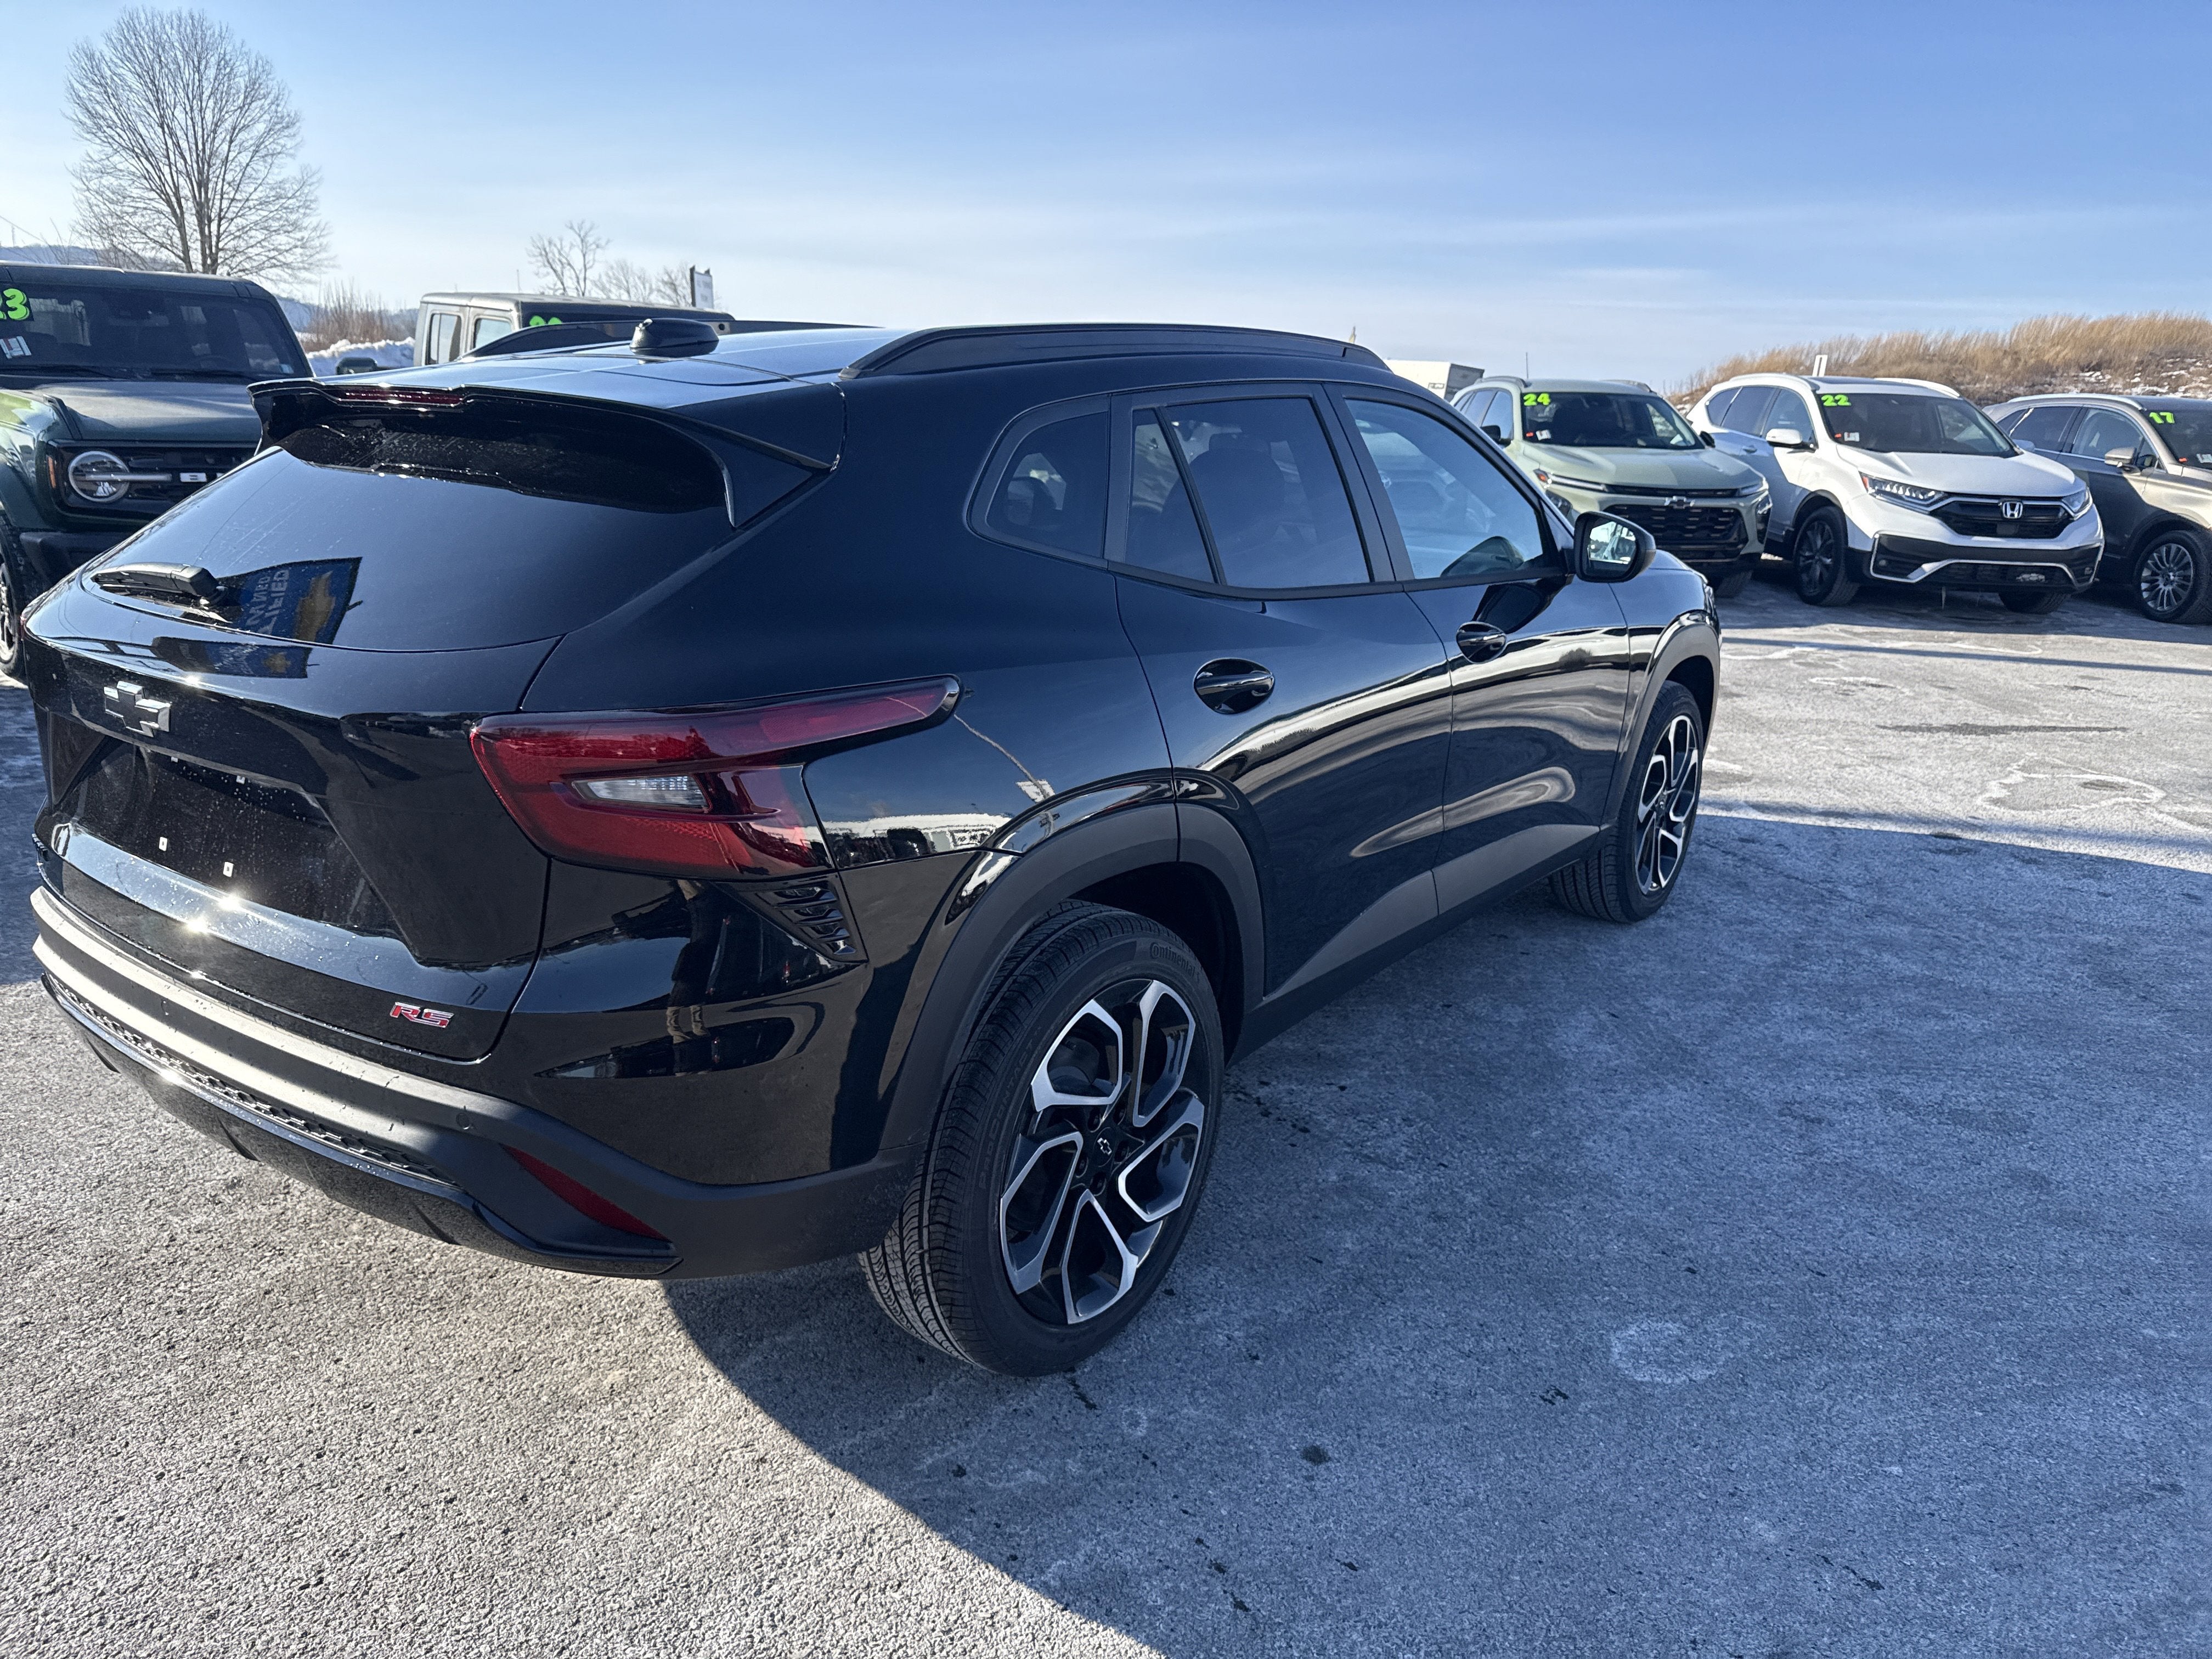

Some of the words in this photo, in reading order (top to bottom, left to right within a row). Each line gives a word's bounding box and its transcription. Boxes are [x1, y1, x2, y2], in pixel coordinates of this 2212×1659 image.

[0, 288, 30, 320] 3
[1523, 393, 1551, 405] 24
[1821, 394, 1852, 406] 22
[2149, 412, 2175, 424] 17
[1150, 942, 1195, 978] Continental
[390, 1002, 454, 1028] RS
